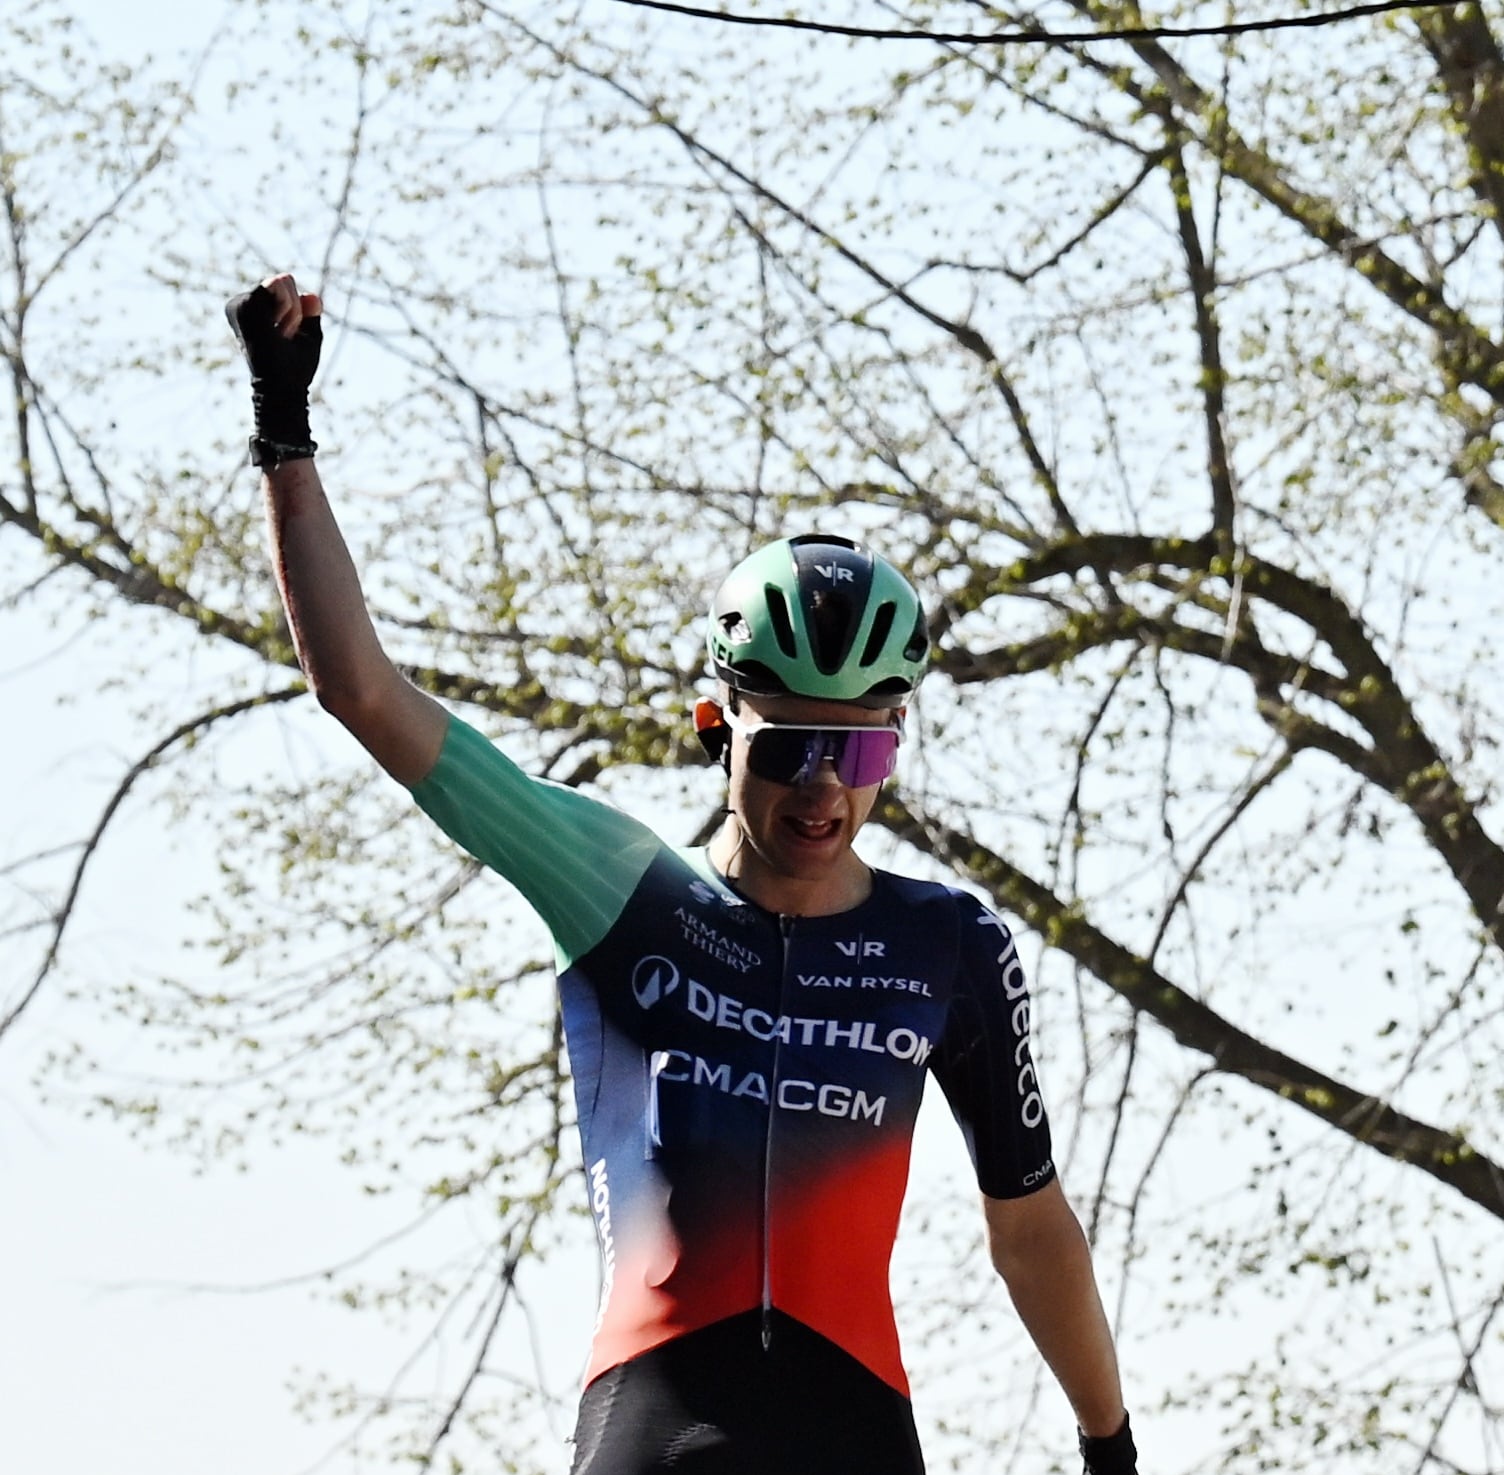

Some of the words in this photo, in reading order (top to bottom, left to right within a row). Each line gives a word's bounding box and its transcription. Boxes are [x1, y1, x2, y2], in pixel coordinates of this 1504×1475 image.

[674, 907, 761, 965] ARMAND
[681, 924, 751, 973] THIERY
[797, 974, 852, 988] VAN
[861, 976, 933, 998] RYSEL
[686, 978, 932, 1066] DECATHLON
[776, 1078, 887, 1127] CGM
